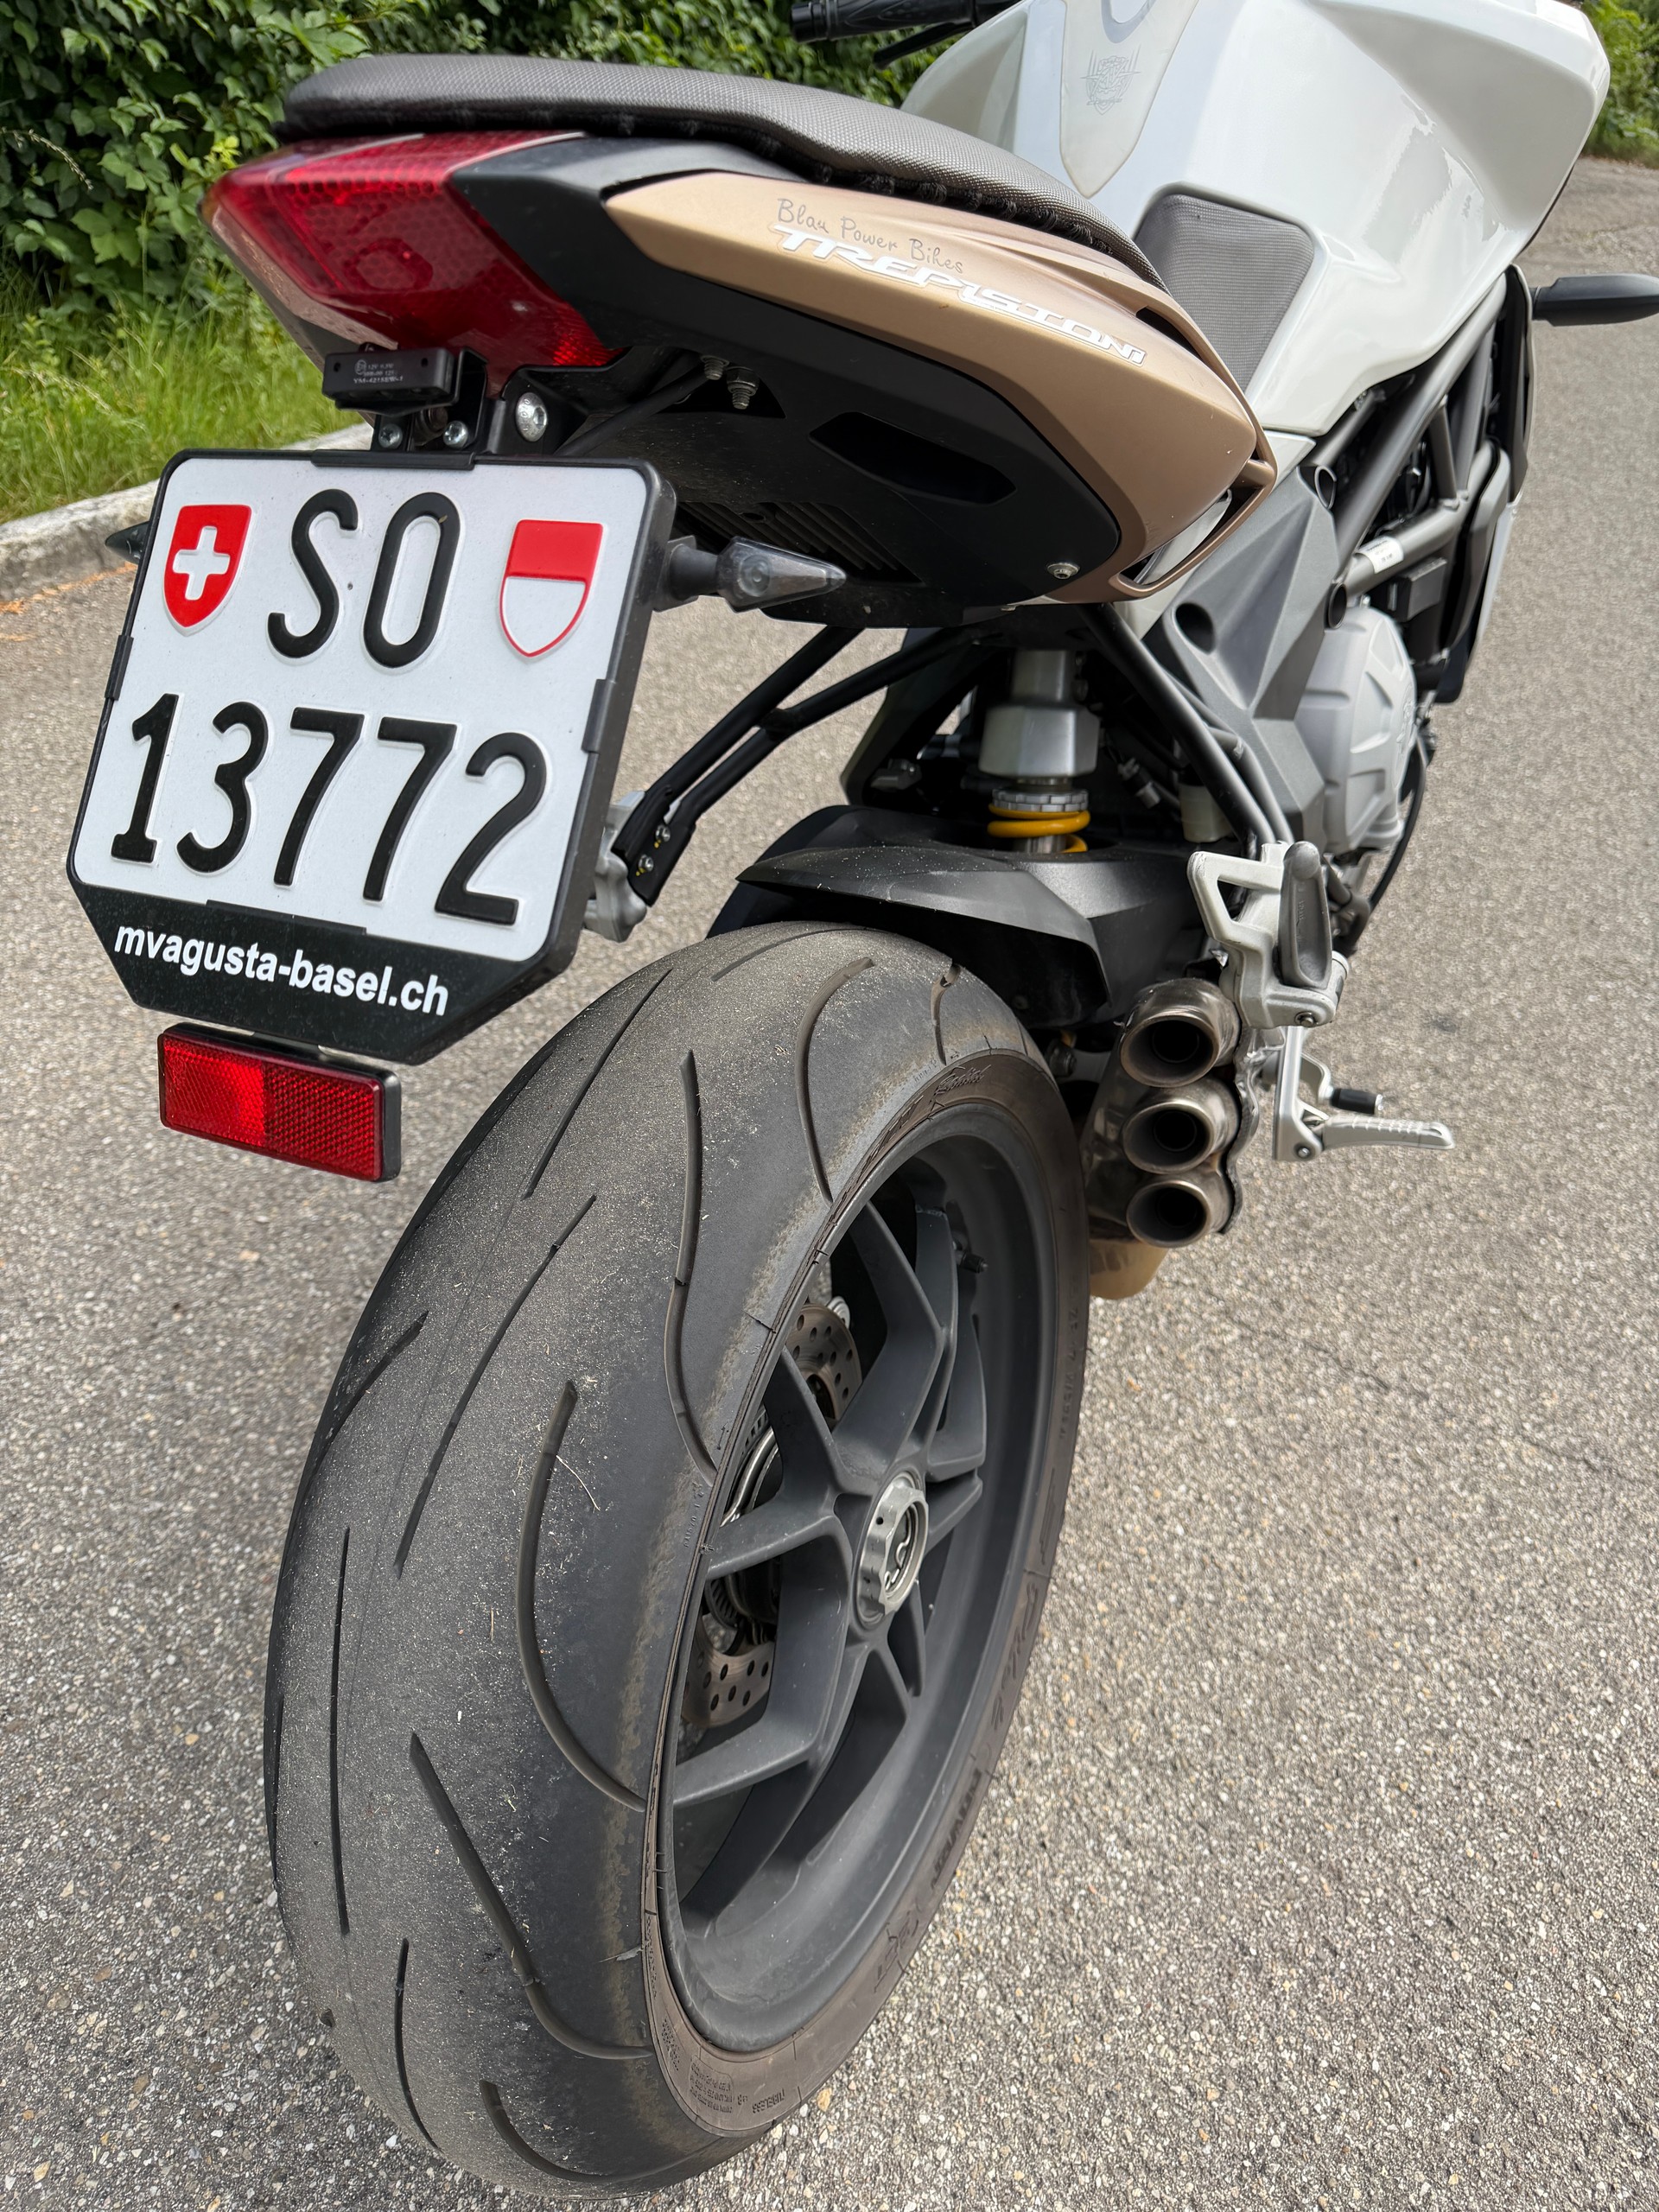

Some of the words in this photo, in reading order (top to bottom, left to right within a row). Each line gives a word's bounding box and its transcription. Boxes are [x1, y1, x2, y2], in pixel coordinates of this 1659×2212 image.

[840, 216, 898, 251] Power
[908, 238, 963, 274] Bikes
[267, 488, 461, 669] SO
[111, 693, 548, 927] 13772
[113, 924, 449, 1016] mvagusta-basel.ch
